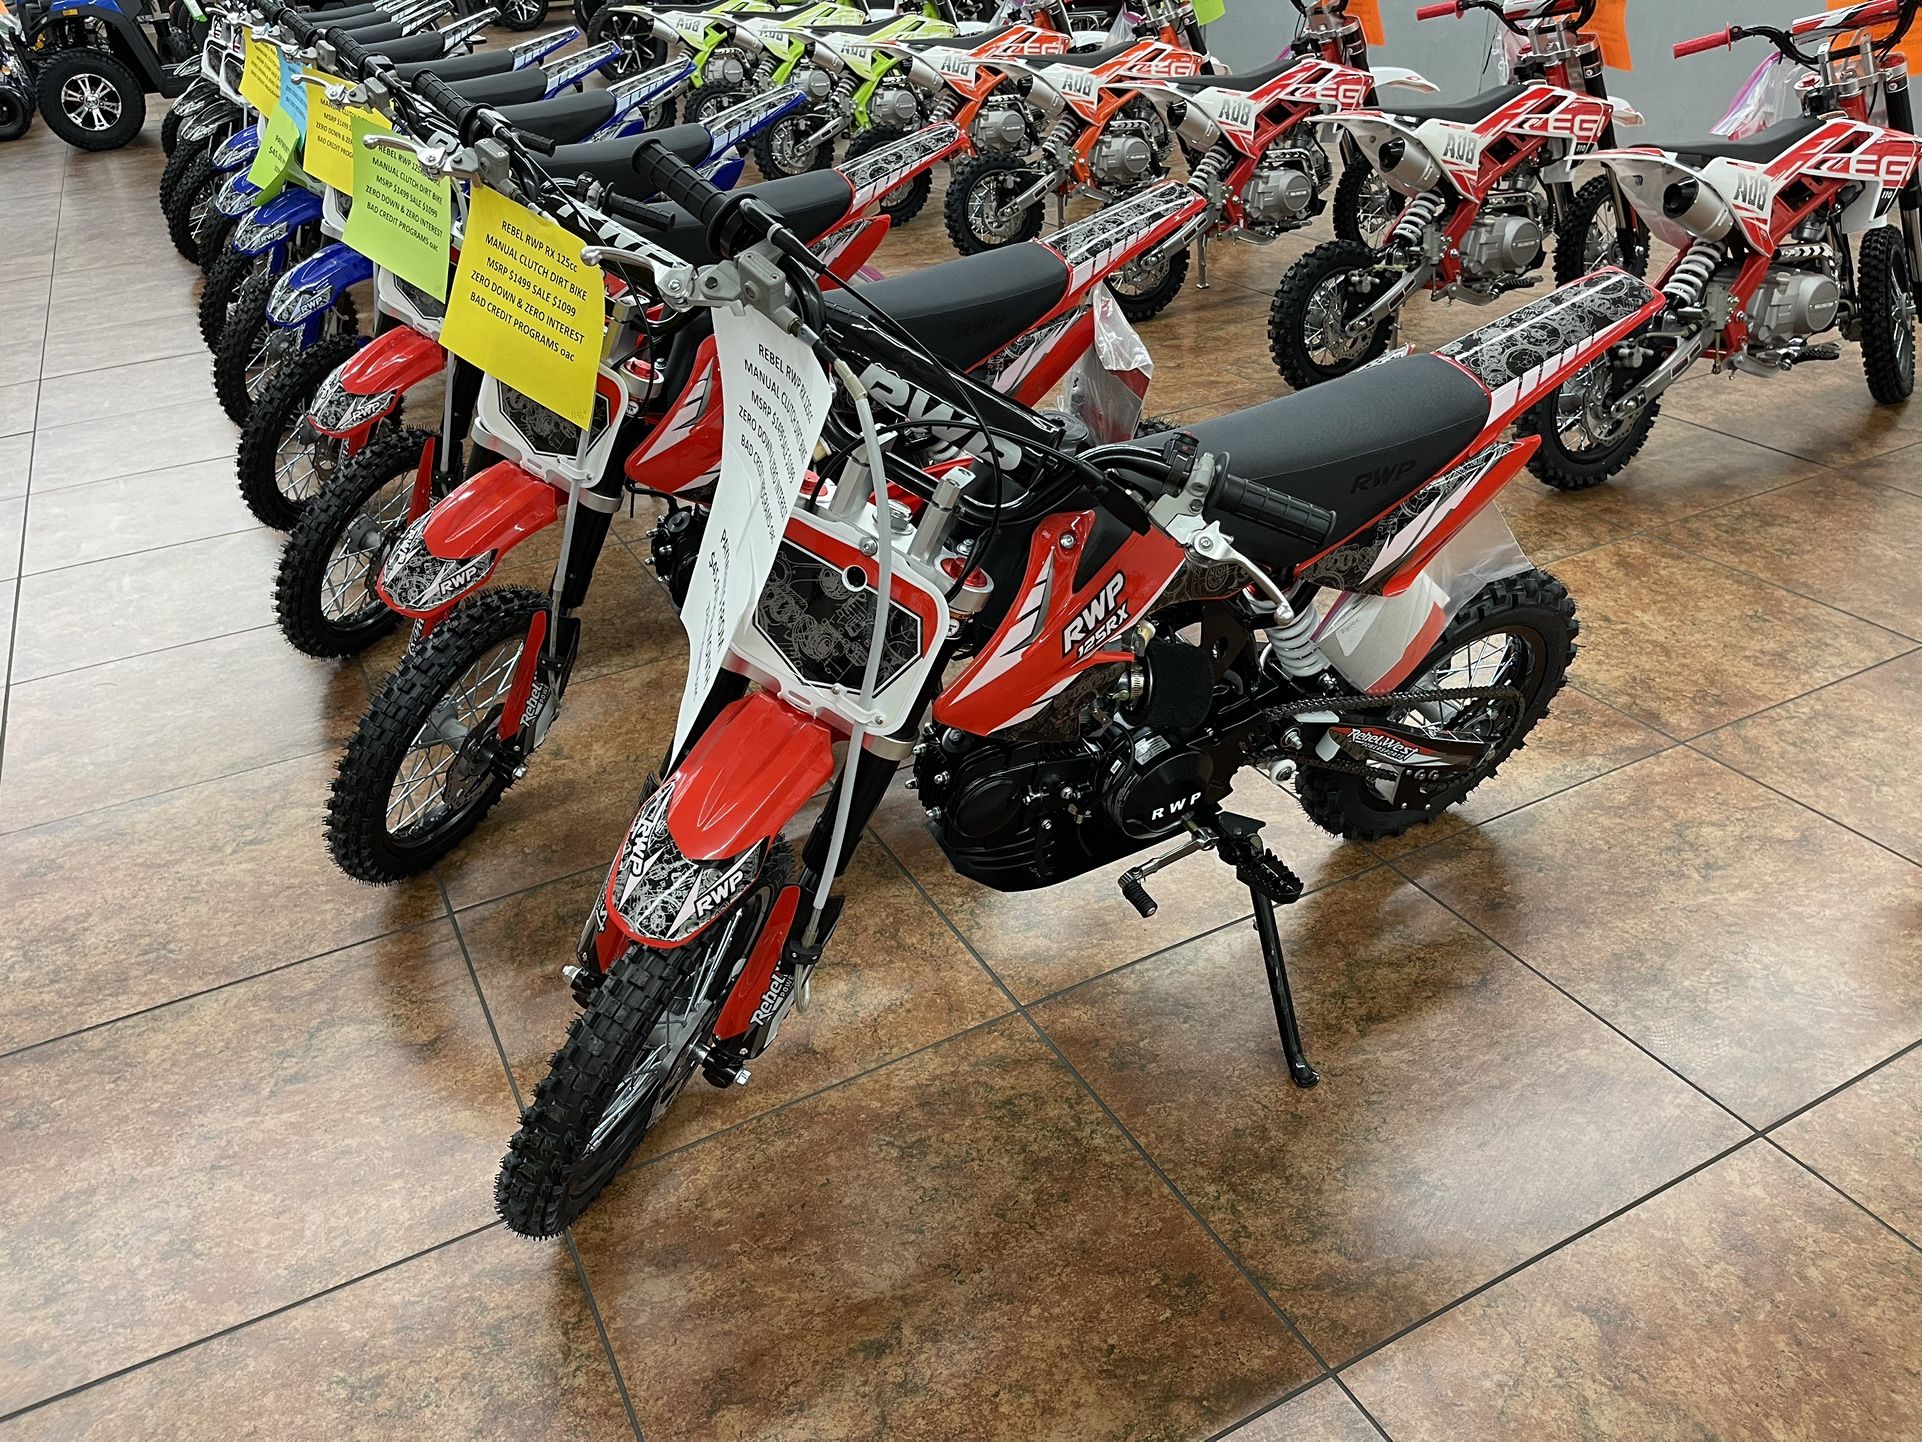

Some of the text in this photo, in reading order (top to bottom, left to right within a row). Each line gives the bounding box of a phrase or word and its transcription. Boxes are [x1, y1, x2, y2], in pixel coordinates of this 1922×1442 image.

[372, 157, 399, 178] MANUAL
[400, 172, 419, 190] CLUTCH
[420, 184, 432, 197] DIRT
[376, 174, 393, 188] MSRP
[410, 194, 422, 208] SALE
[1881, 190, 1893, 199] 110
[365, 184, 381, 198] ZERO
[381, 193, 400, 210] DOWN
[405, 208, 419, 222] ZERO
[420, 217, 443, 238] INTEREST
[366, 201, 378, 213] BAD
[379, 209, 398, 225] CREDIT
[398, 220, 429, 245] PROGRAMS
[485, 233, 588, 302] MANUAL CLUTCH DIRT BIKE
[501, 219, 578, 273] REBEL RWP RX 125cc
[301, 297, 322, 314] RWP
[470, 269, 585, 345] ZERO DOWN & ZERO INTEREST
[486, 257, 577, 317] MSRP $1499 SALE $1099
[470, 291, 575, 362] BAD CREDIT PROGRAMS oac
[744, 358, 780, 400] MANUAL
[758, 343, 784, 374] REBEL
[785, 364, 802, 390] RWP
[352, 401, 380, 421] RWP
[751, 390, 772, 418] MSRP
[738, 404, 757, 431] ZERO
[757, 425, 774, 460] DOWN
[740, 433, 754, 457] BAD
[1350, 459, 1416, 496] RWP
[440, 566, 477, 595] RWP
[1063, 572, 1125, 655] RWP
[1078, 602, 1128, 659] 125RX
[520, 682, 543, 727] Rebel
[632, 820, 654, 875] RWP
[695, 870, 743, 918] RWP
[750, 973, 788, 1026] Rebel
